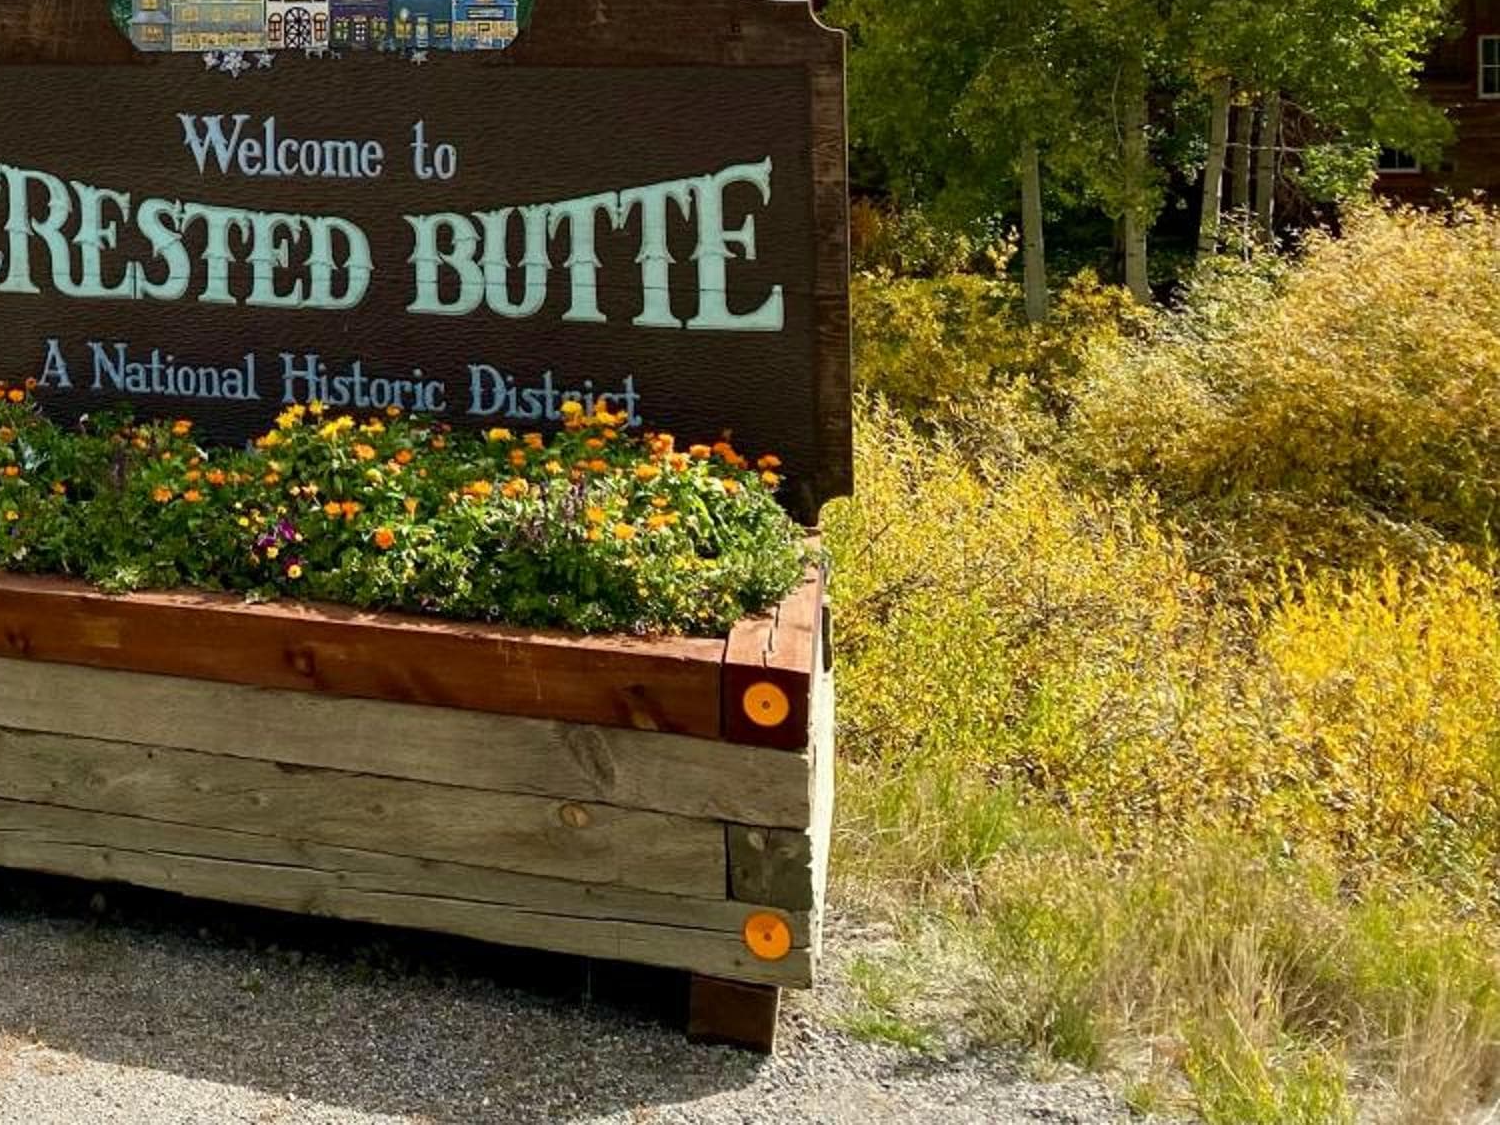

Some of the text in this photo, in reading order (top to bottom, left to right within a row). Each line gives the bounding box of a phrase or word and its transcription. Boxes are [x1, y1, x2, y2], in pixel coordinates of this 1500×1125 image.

[177, 112, 457, 180] Welcome to
[403, 156, 785, 330] BUTTE
[38, 338, 72, 388] A
[88, 341, 260, 401] National
[279, 352, 447, 412] Historic
